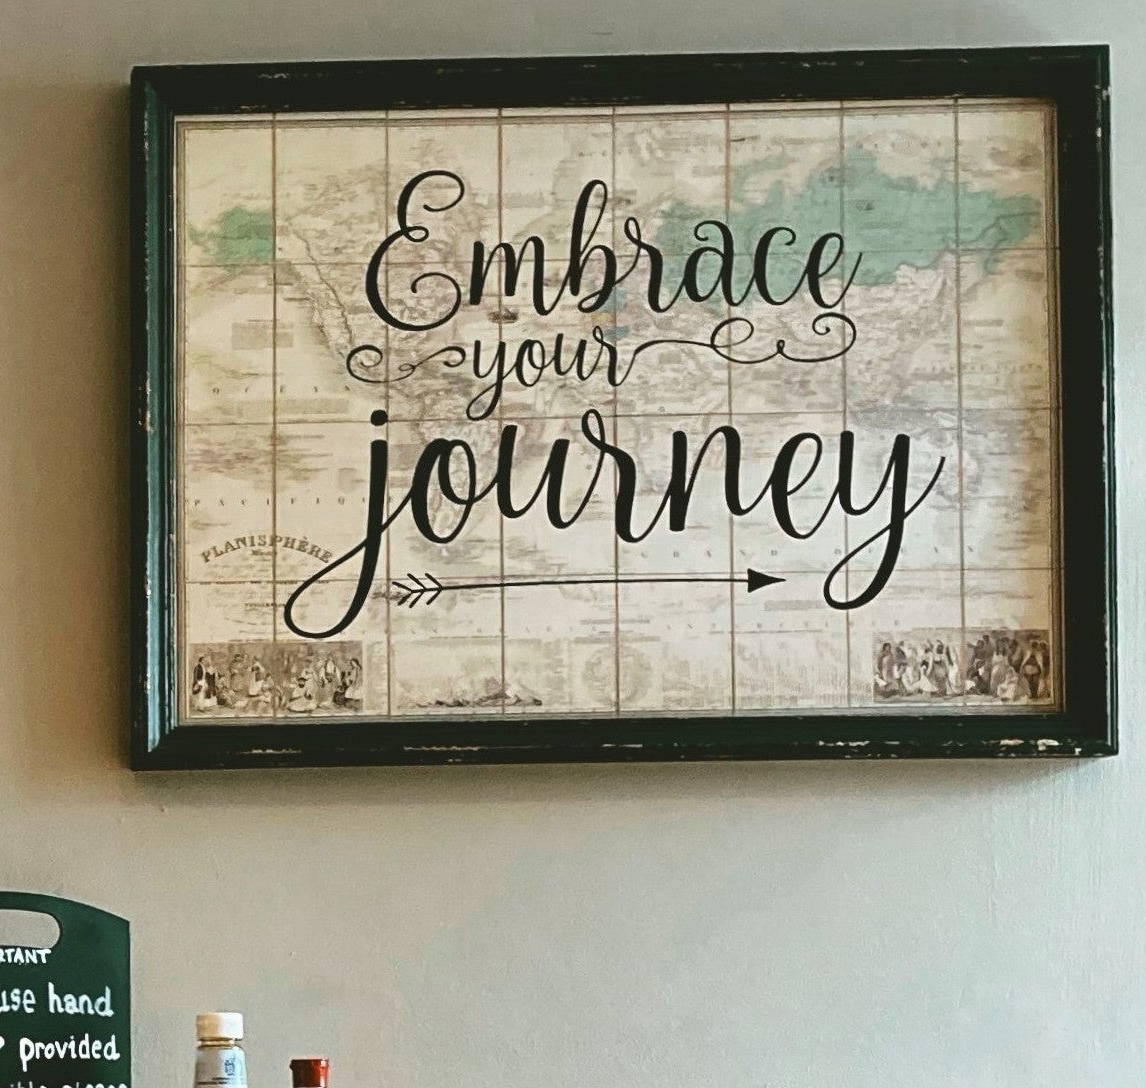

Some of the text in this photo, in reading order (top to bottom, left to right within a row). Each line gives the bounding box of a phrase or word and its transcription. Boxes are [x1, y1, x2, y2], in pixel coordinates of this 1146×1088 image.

[365, 169, 864, 332] Embrace
[466, 326, 637, 421] your
[201, 534, 333, 563] PLANISPHÈRE
[283, 409, 946, 639] journey
[48, 981, 114, 1017] hand
[19, 1033, 121, 1073] provided
